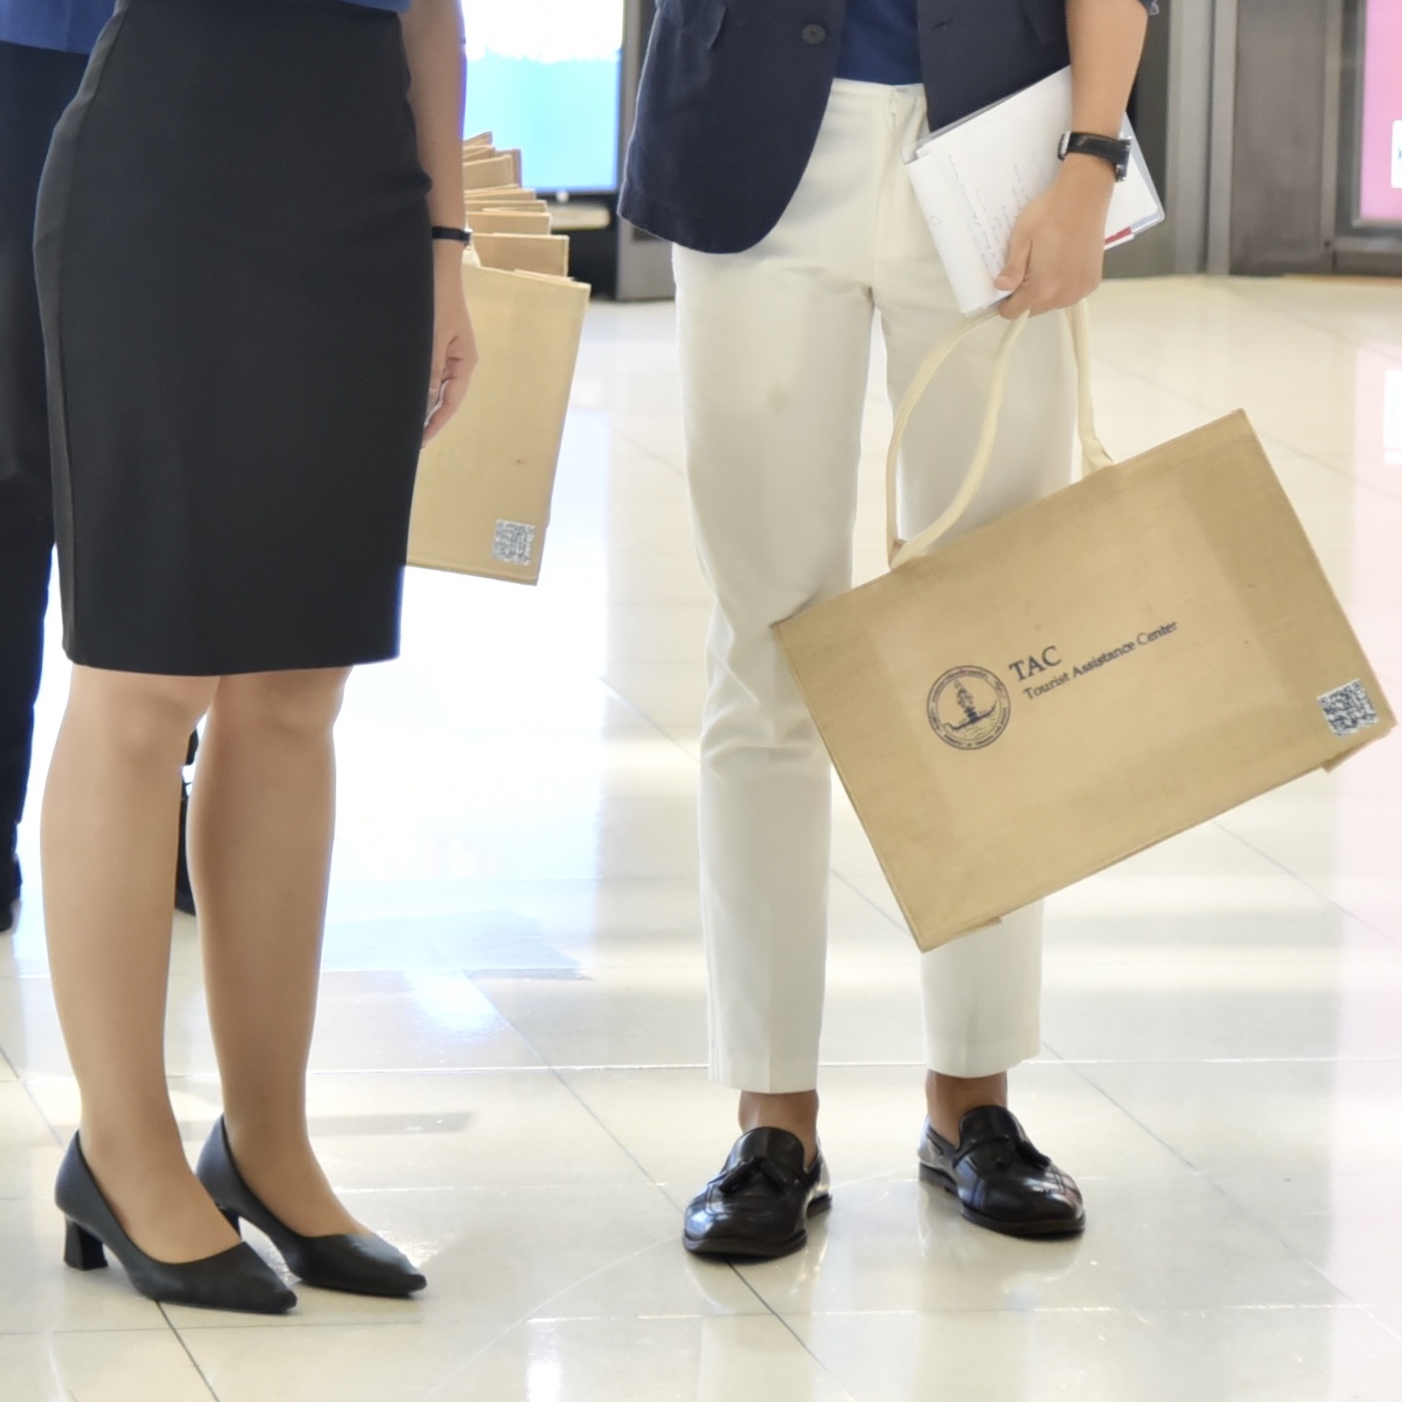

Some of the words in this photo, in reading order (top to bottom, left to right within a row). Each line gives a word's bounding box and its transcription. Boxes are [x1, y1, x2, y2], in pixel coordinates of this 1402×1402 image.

[1008, 645, 1062, 682] TAC
[1023, 672, 1070, 700] Tourist
[1072, 641, 1136, 678] Assistance
[1136, 621, 1178, 646] Center
